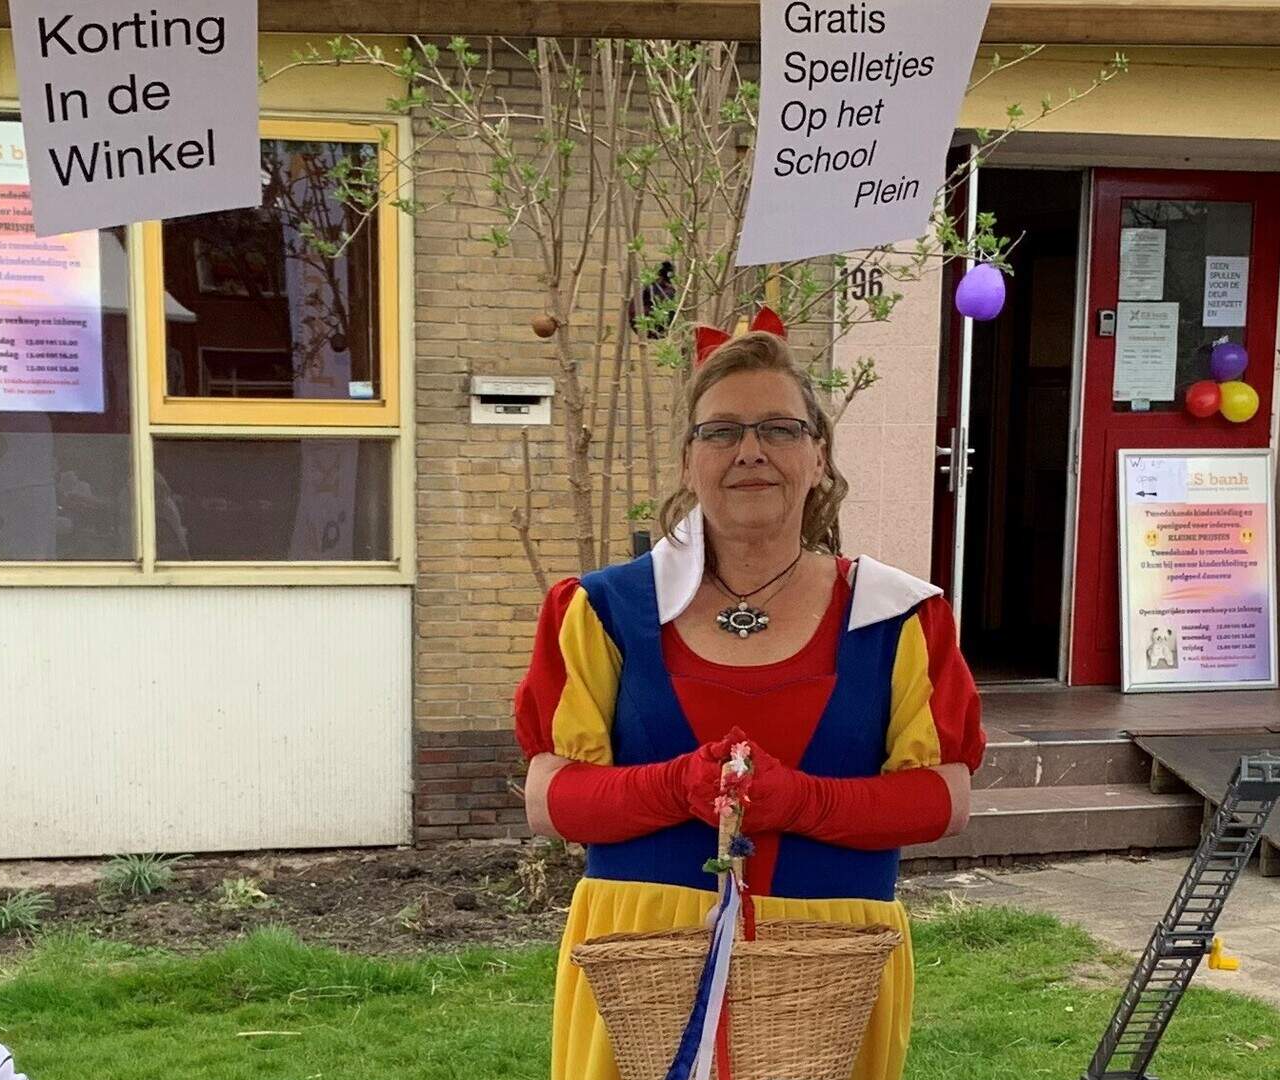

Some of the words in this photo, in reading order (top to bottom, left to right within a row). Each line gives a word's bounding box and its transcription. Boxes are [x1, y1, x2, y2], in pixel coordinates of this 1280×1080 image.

[38, 9, 226, 58] Korting
[784, 1, 886, 34] Gratis
[784, 51, 935, 90] Spelletjes
[44, 83, 89, 123] In
[108, 74, 171, 115] de
[781, 100, 827, 137] Op
[837, 99, 884, 128] het
[48, 128, 216, 187] Winkel
[774, 140, 877, 177] School
[854, 175, 920, 208] Plein
[839, 266, 884, 300] 196
